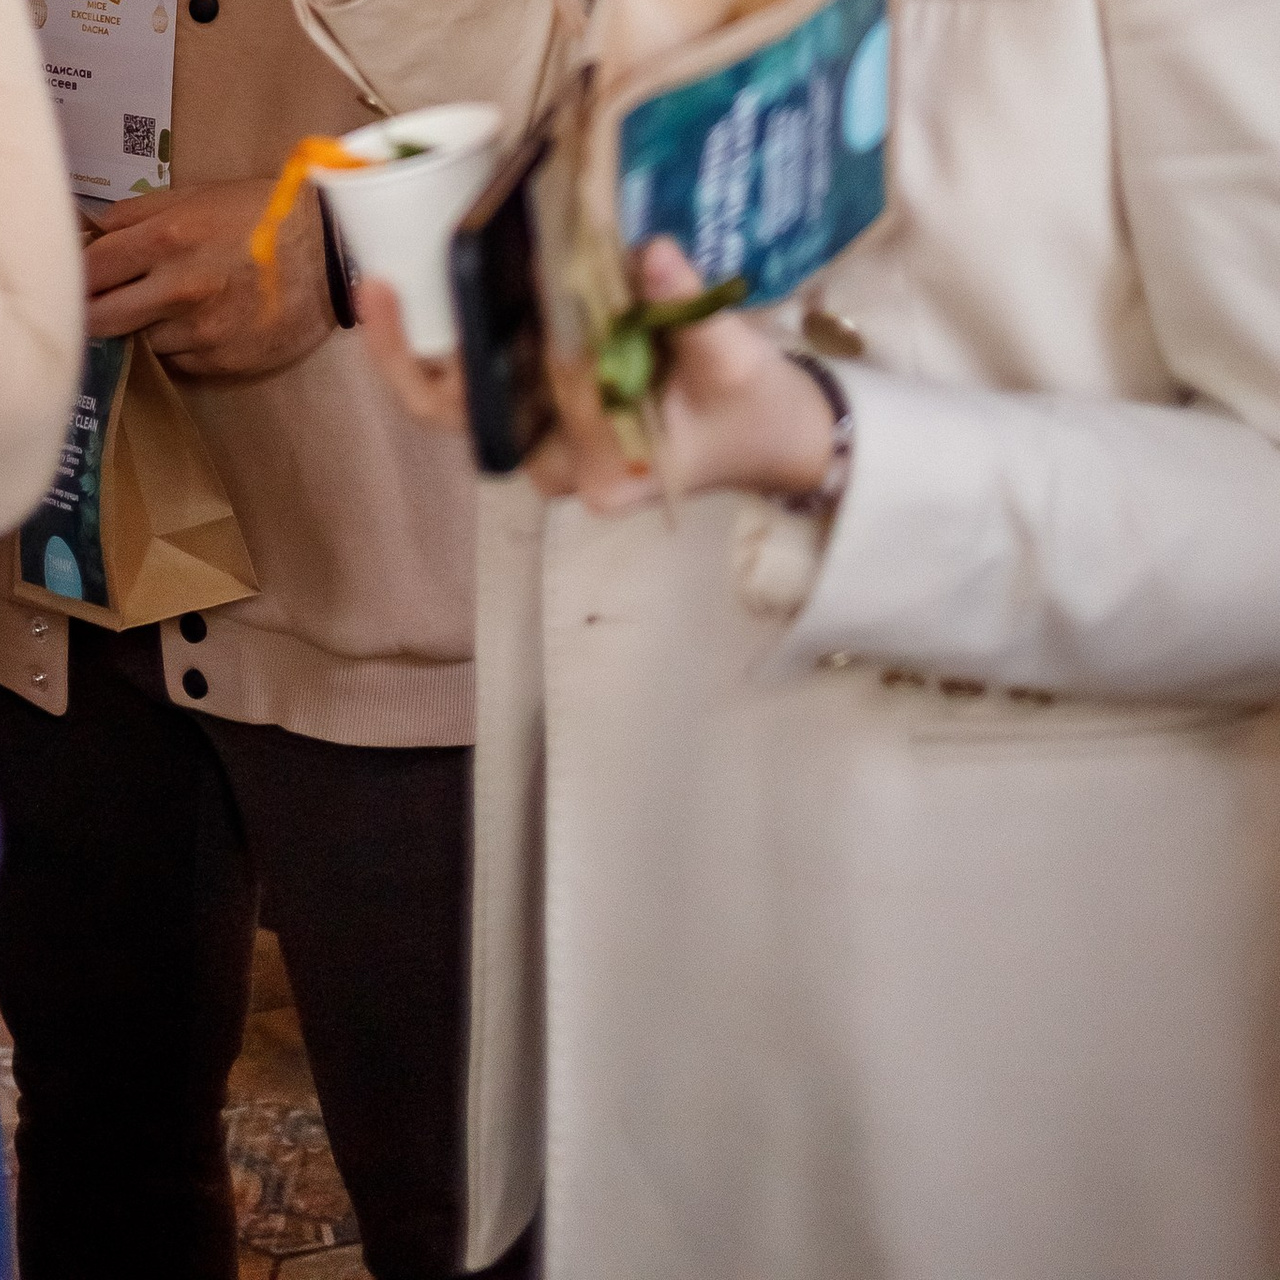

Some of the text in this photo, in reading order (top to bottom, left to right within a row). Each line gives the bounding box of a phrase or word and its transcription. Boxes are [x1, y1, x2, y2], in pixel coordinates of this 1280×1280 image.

[87, 0, 108, 11] MICE
[71, 10, 122, 26] EXCELLENCE
[81, 23, 110, 36] DACHA
[42, 63, 92, 79] адислав
[70, 172, 111, 187] dacha2024
[76, 394, 97, 413] REEN,
[75, 414, 99, 433] CLEAN
